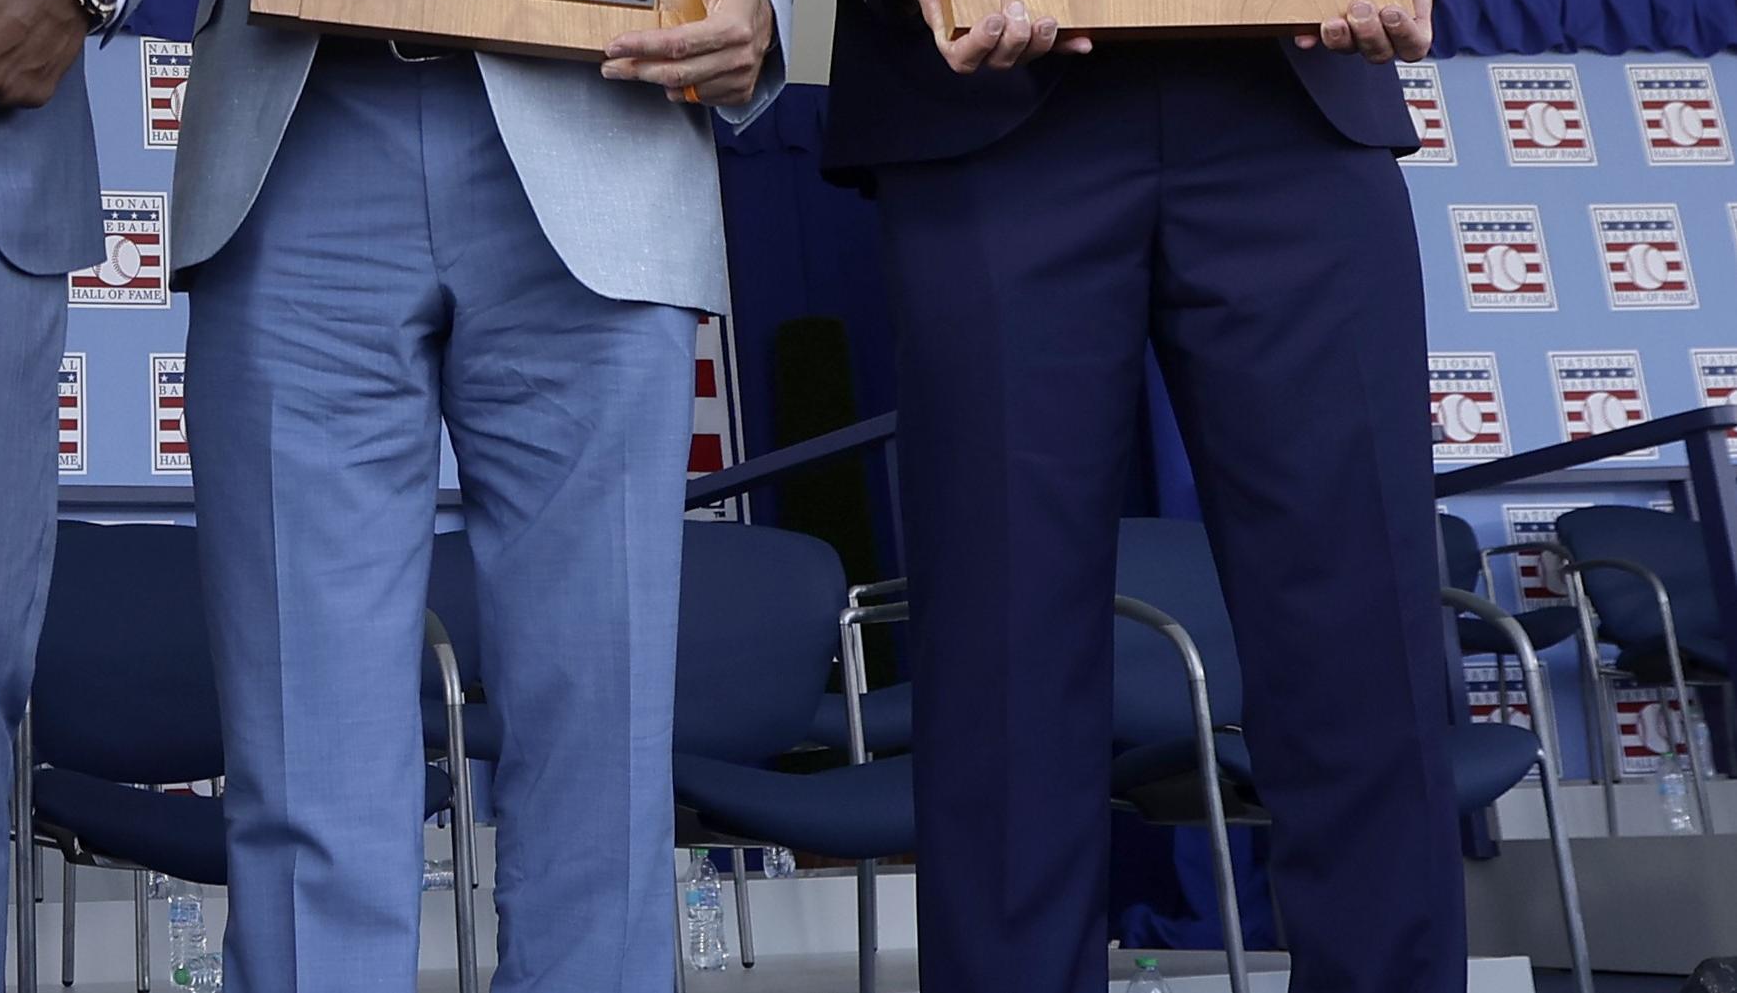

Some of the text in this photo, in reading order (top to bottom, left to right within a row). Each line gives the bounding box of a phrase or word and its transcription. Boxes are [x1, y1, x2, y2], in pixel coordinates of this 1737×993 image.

[71, 288, 164, 301] HALL OF FAME
